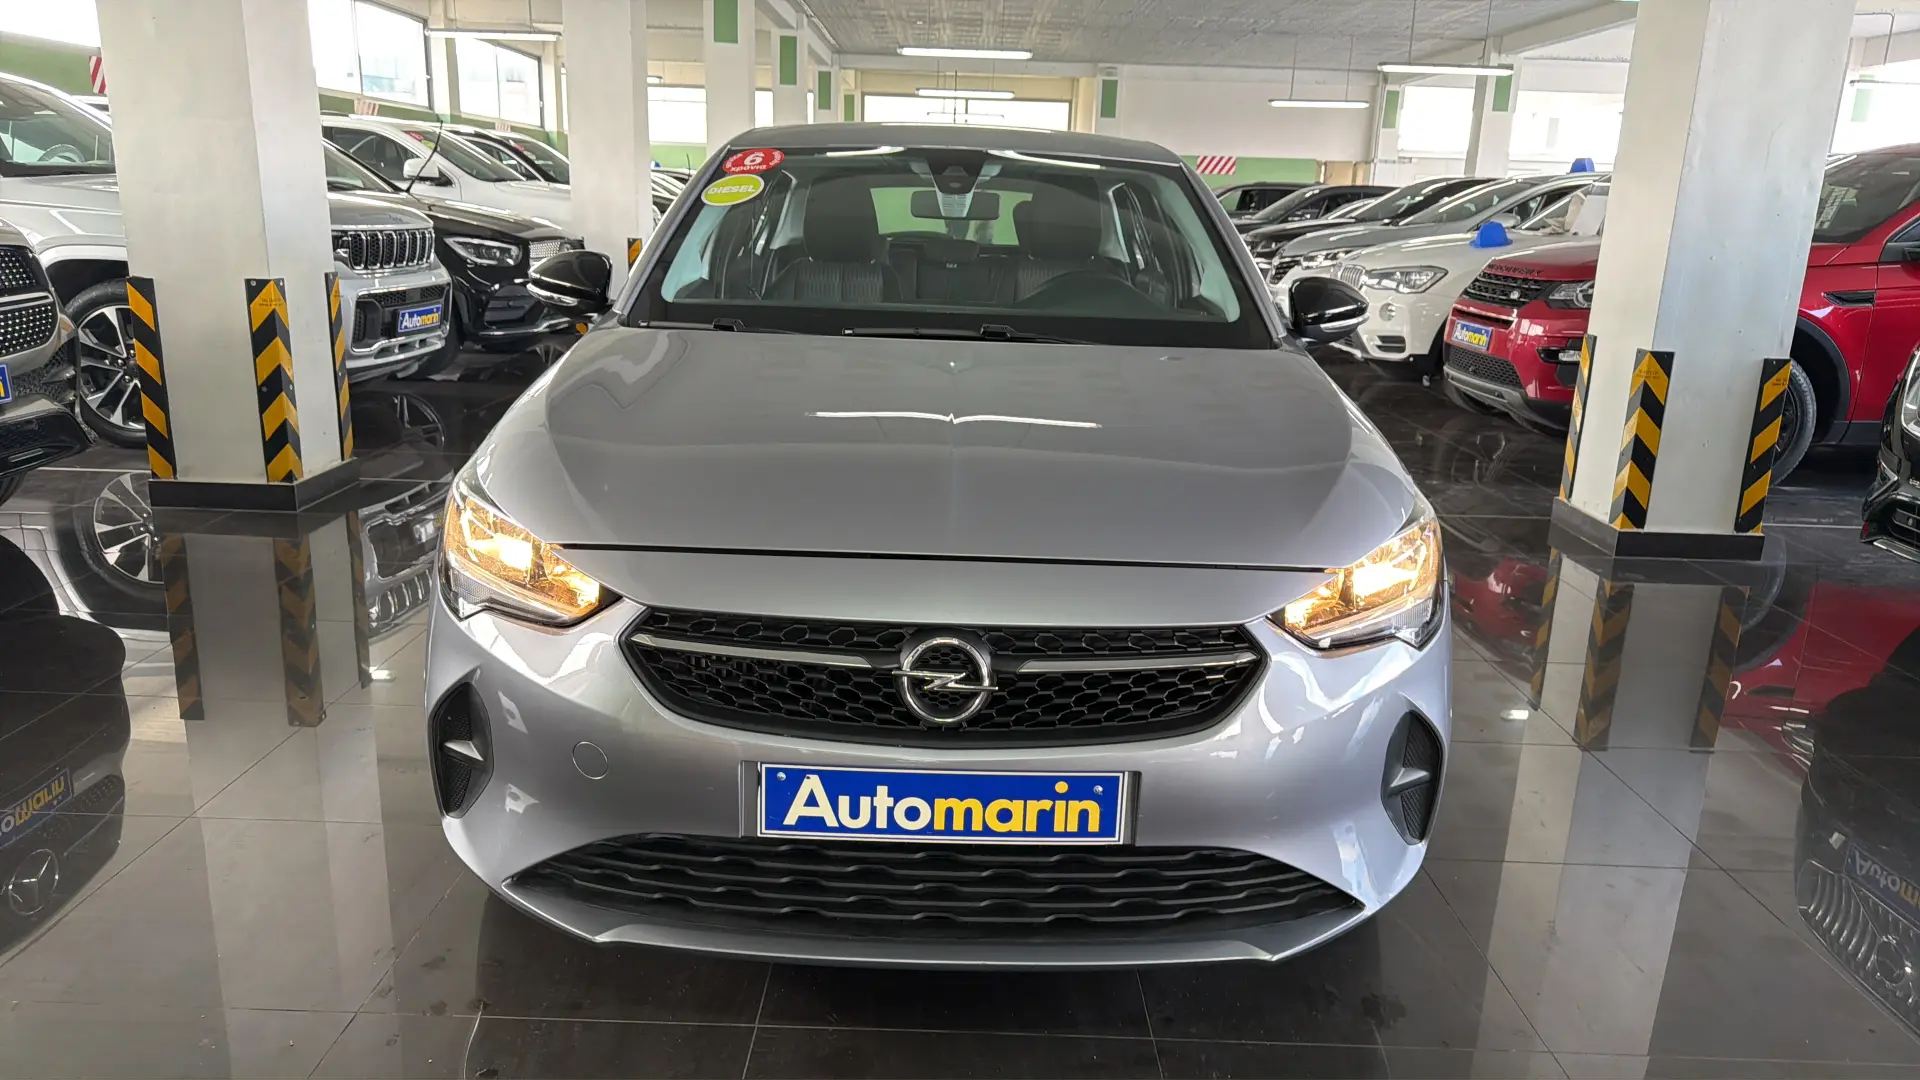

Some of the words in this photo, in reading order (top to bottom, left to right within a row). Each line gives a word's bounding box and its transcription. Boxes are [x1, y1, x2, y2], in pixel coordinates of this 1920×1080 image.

[743, 151, 765, 166] 6
[707, 184, 756, 195] DIESEL
[401, 309, 439, 329] Automarin
[1453, 323, 1488, 347] Automarin
[782, 773, 1100, 833] Automarin
